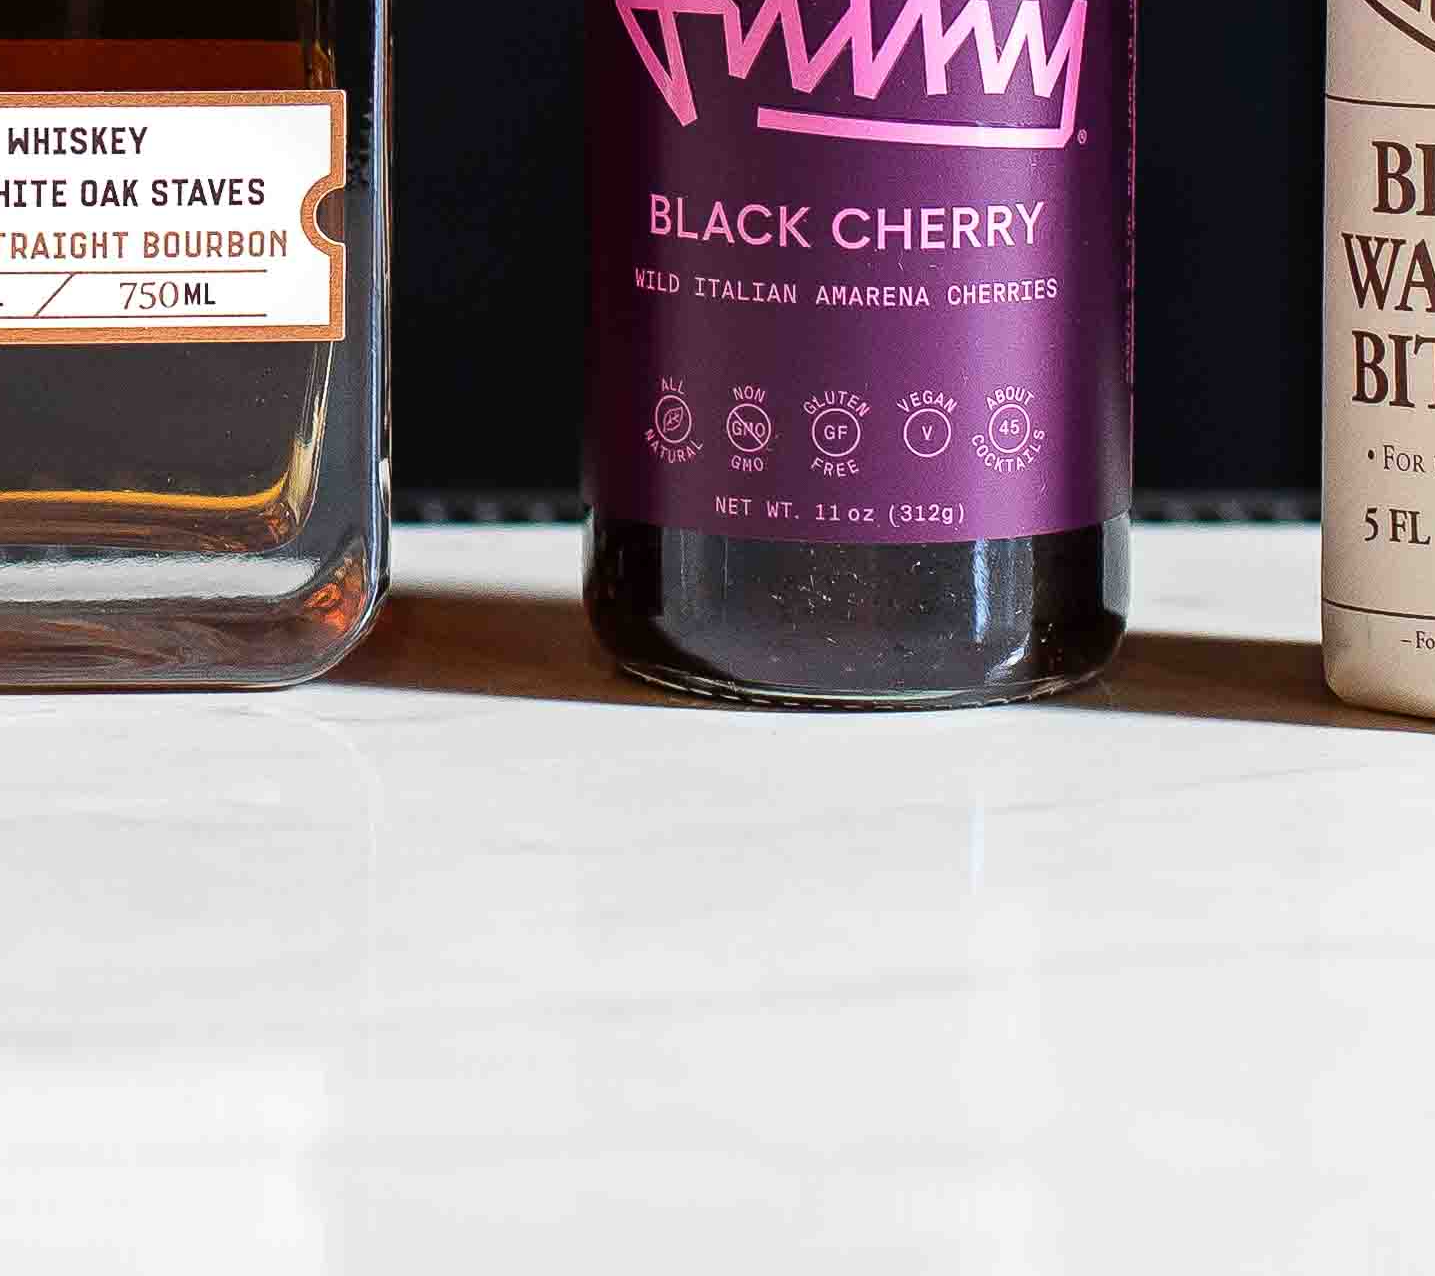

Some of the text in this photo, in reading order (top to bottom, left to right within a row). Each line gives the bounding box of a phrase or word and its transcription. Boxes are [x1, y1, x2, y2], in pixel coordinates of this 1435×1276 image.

[8, 126, 148, 155] WHISKEY
[80, 179, 138, 207] OAK
[150, 178, 266, 207] STAVES
[649, 194, 1045, 249] BLACK CHERRY
[143, 230, 288, 259] BOURBON
[635, 267, 1058, 307] WILD ITALIAN AMARENA CHERRIES
[660, 376, 685, 394] ALL
[733, 386, 766, 403] NON
[985, 386, 1035, 412] ABOUT
[803, 390, 872, 418] GLUTEN
[897, 390, 958, 416] VEGAN
[824, 425, 848, 440] GF
[921, 425, 934, 441] V
[998, 419, 1021, 435] 45
[645, 429, 704, 464] NATURAL
[972, 427, 1046, 473] COCKTAILS
[731, 455, 764, 472] GMO
[811, 457, 860, 477] FREE
[715, 495, 751, 518] NET
[767, 501, 799, 520] WT.
[888, 503, 966, 526] (312g)
[1363, 507, 1378, 542] 5
[1389, 510, 1431, 546] FL
